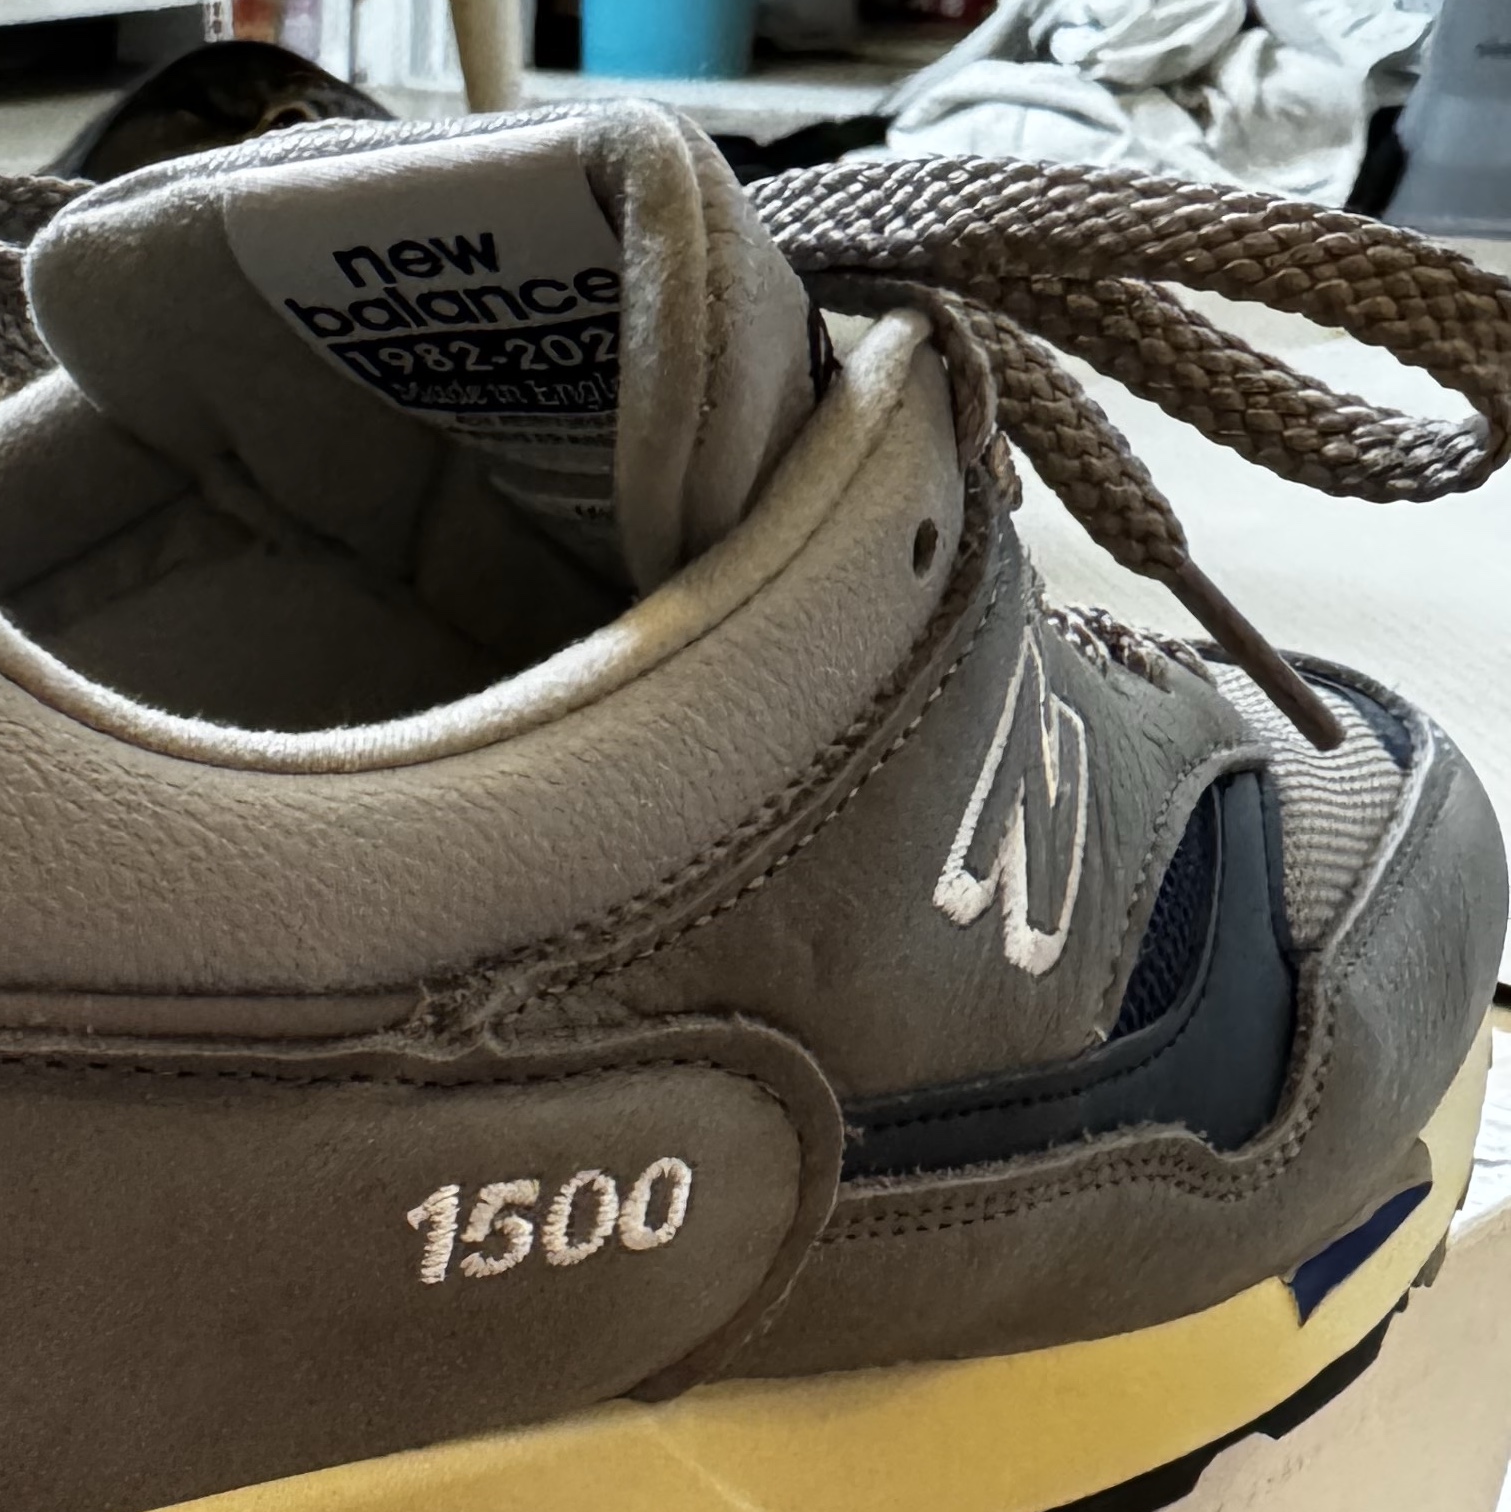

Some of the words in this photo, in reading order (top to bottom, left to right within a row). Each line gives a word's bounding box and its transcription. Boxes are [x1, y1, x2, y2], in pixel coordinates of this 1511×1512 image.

[333, 232, 500, 288] new
[285, 267, 620, 338] balance
[343, 326, 618, 377] 1982-202
[406, 1156, 692, 1284] 1500
